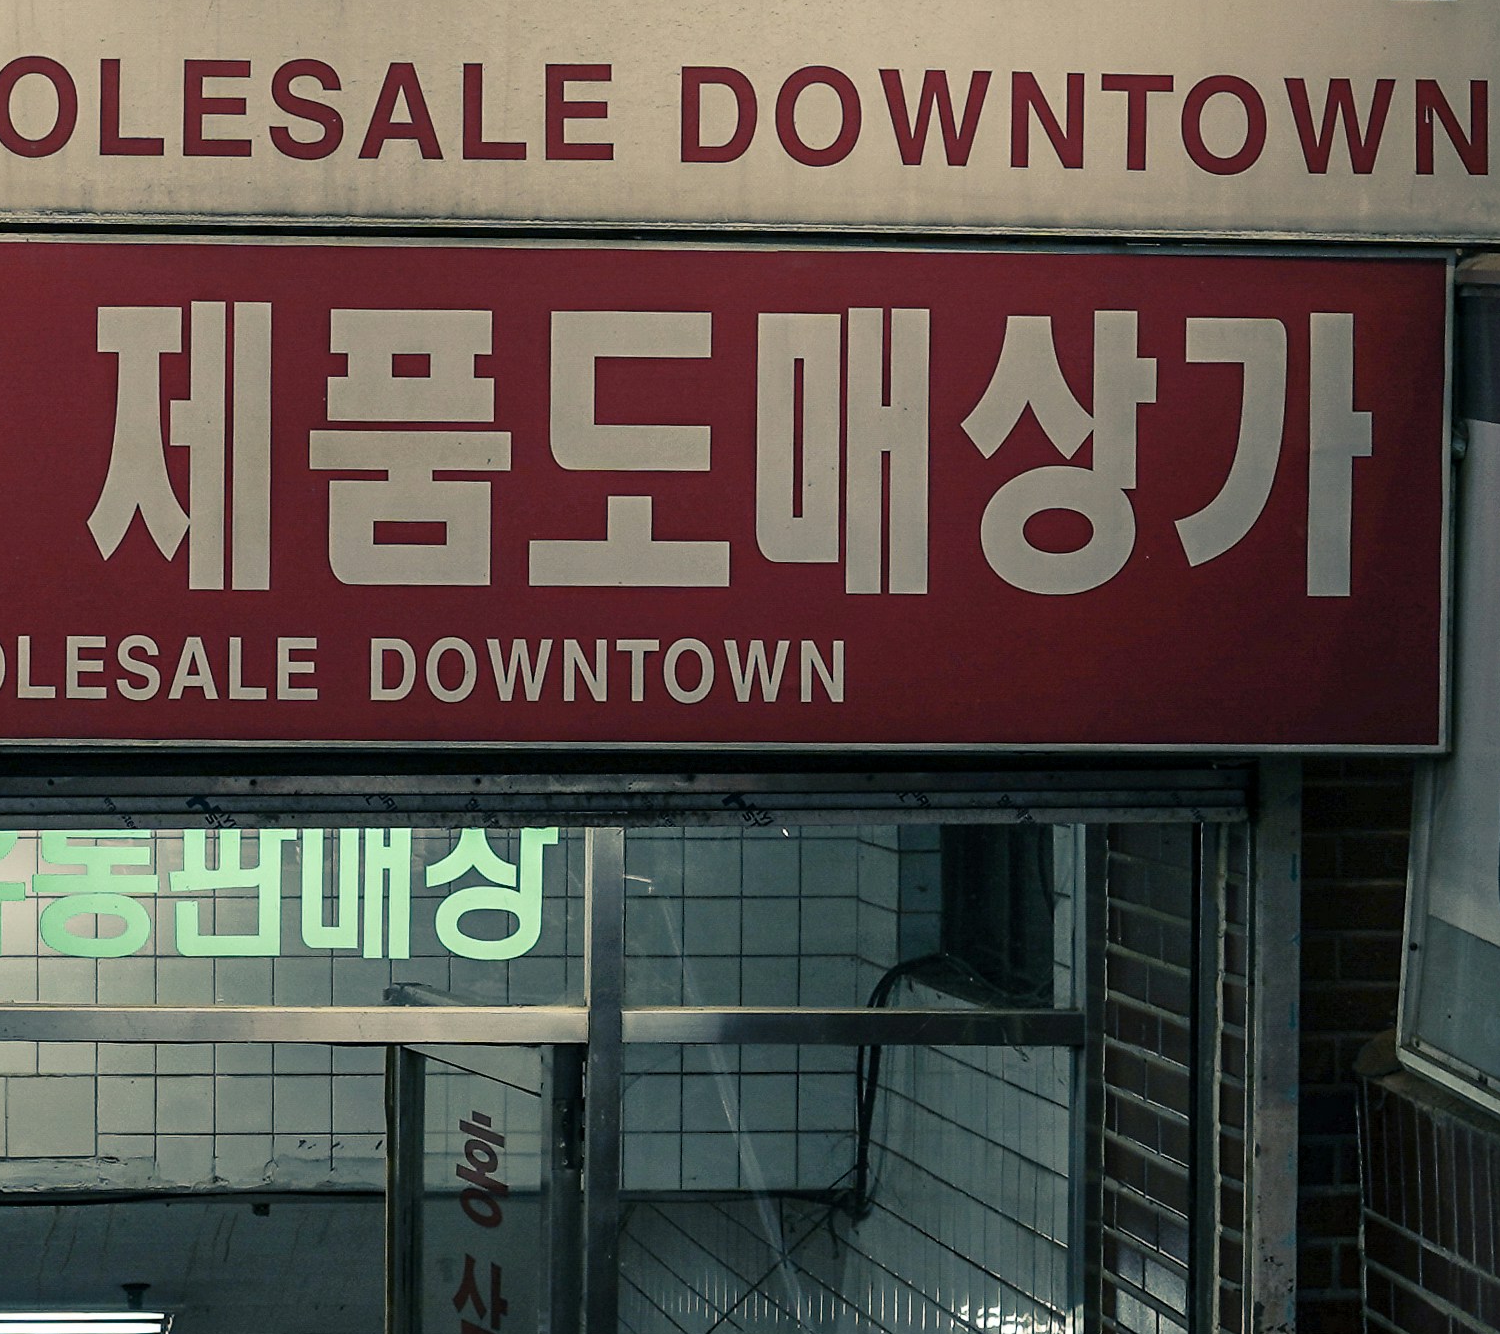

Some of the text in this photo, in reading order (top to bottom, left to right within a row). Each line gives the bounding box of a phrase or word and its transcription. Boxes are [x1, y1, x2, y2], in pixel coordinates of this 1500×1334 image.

[679, 65, 1490, 178] DOWNTOWN
[86, 301, 1372, 597] 제품도매상가
[369, 637, 848, 705] DOWNTOWN
